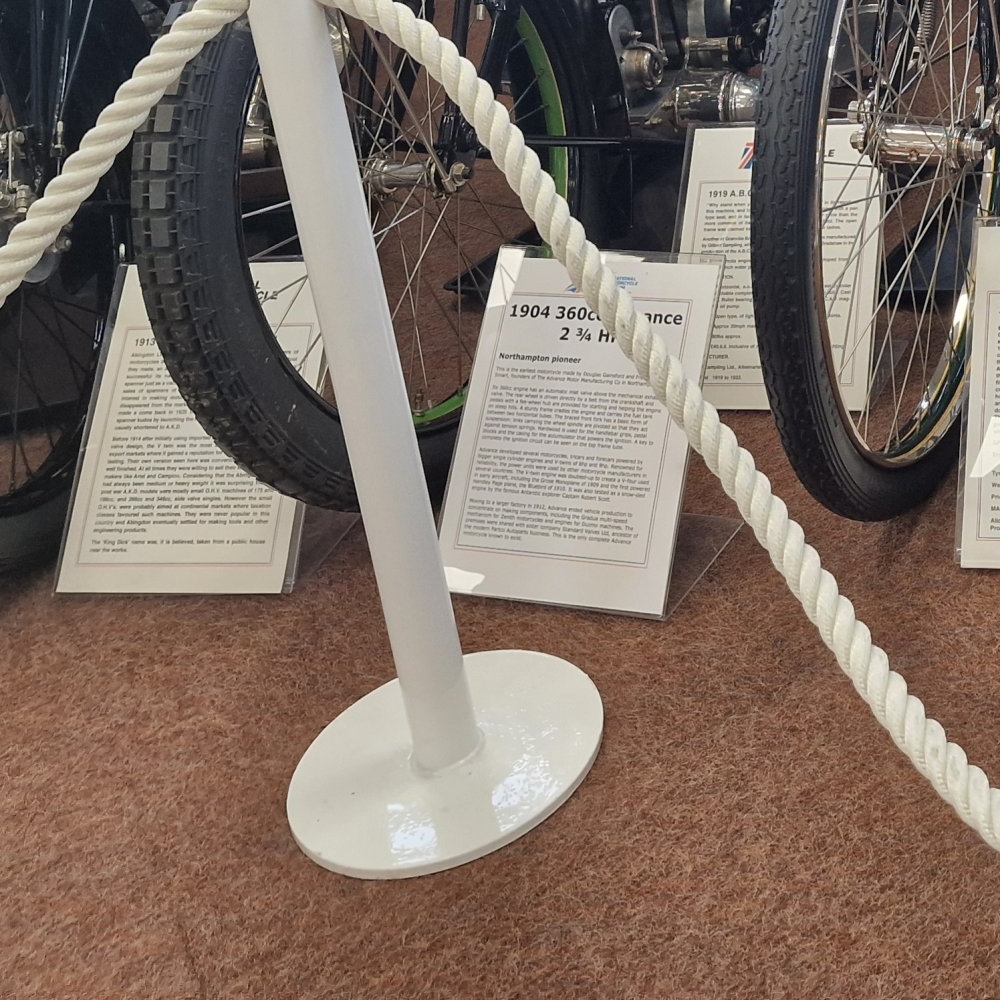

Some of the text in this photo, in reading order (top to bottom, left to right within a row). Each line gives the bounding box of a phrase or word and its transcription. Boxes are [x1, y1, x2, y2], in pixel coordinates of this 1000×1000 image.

[709, 190, 728, 198] 1919
[509, 304, 550, 319] 1904
[560, 327, 569, 341] 2
[135, 338, 155, 346] 1913
[498, 352, 581, 364] Northampton pioneer
